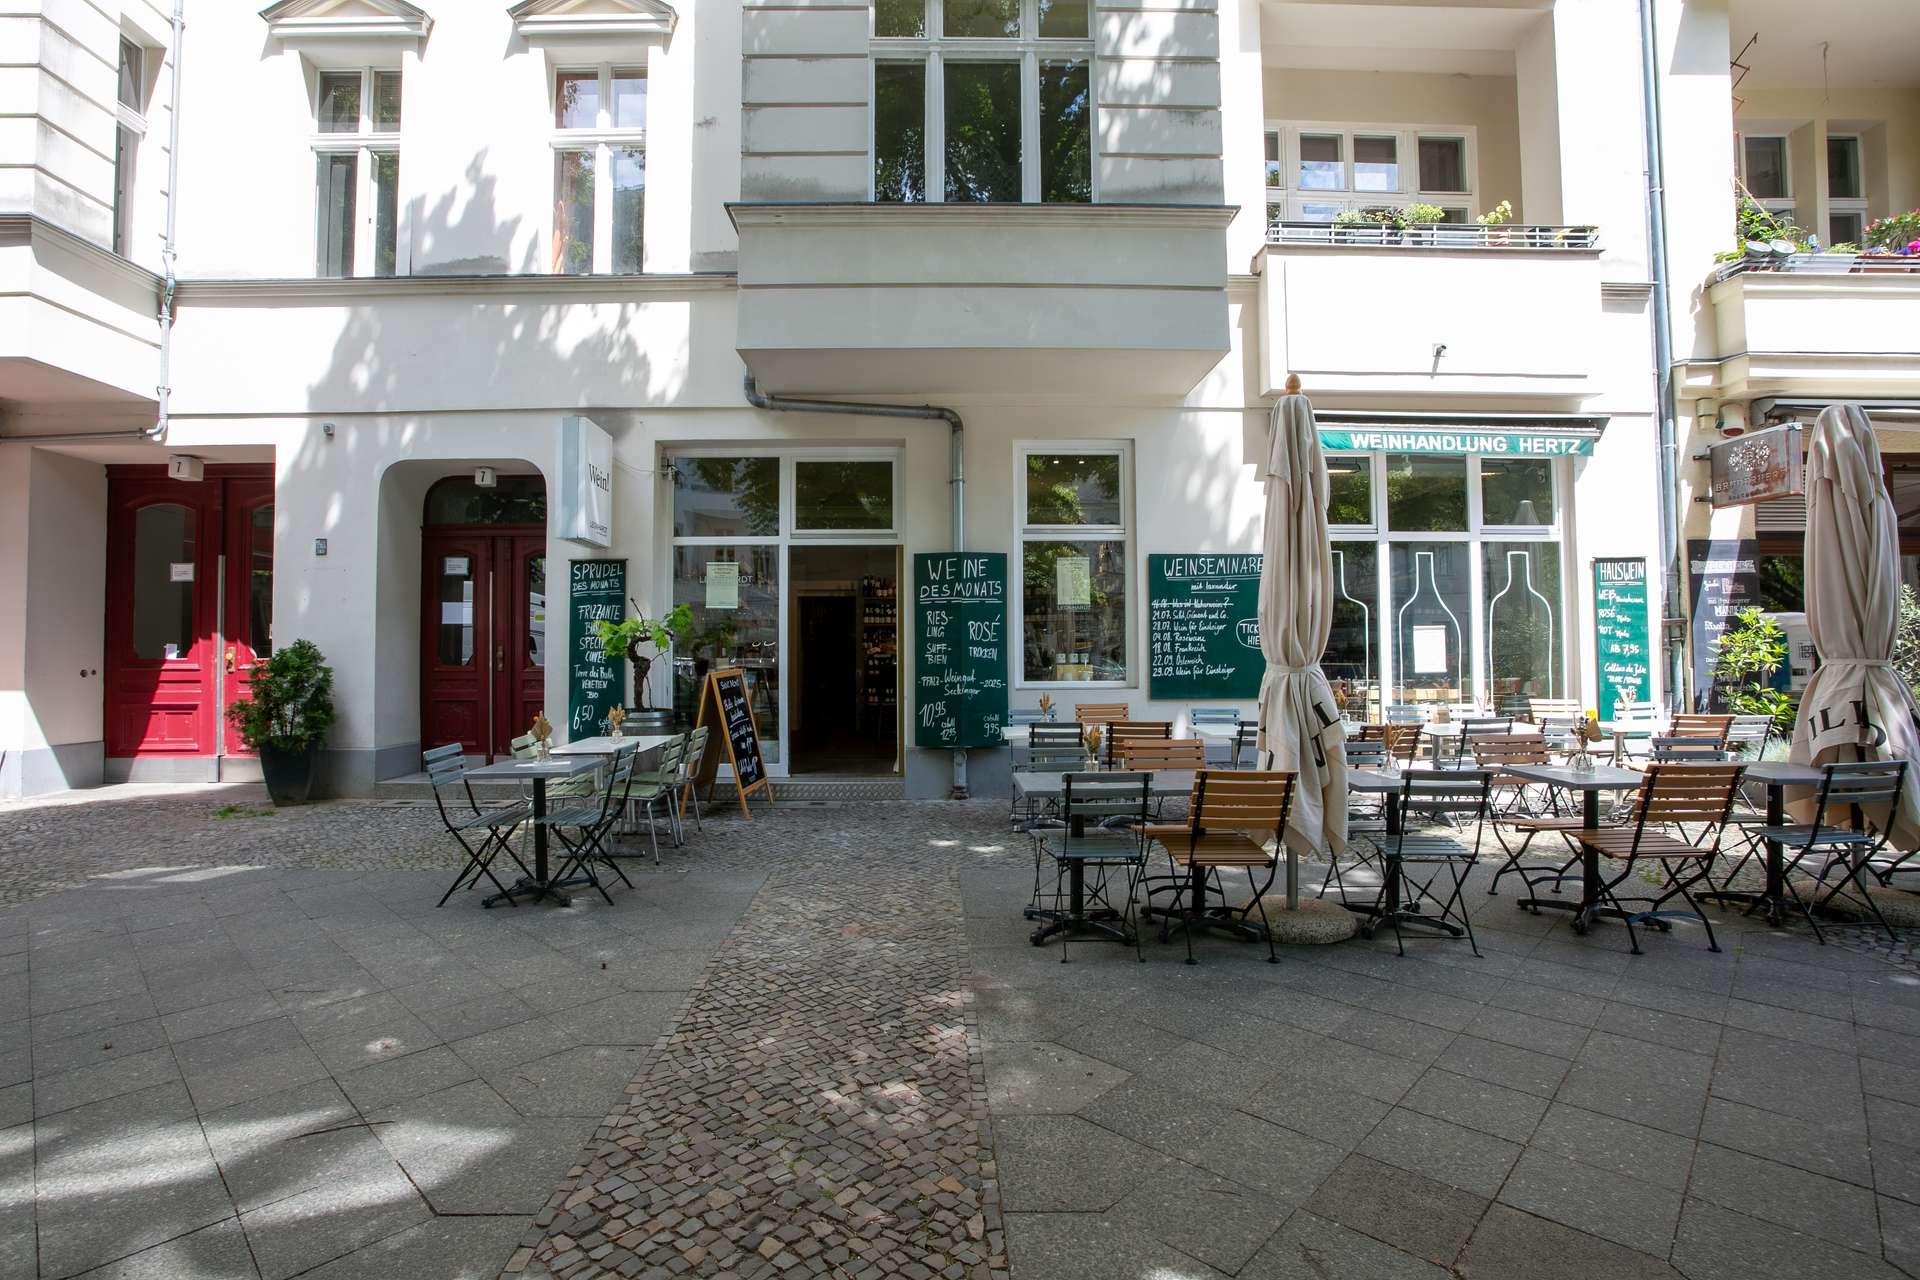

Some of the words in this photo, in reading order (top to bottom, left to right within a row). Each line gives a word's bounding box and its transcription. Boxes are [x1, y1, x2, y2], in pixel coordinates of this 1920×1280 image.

[1350, 433, 1507, 452] WEINHANDLUNG
[1519, 437, 1581, 453] HERTZ
[480, 470, 486, 483] 7
[573, 563, 623, 580] SPRUDEL
[1164, 557, 1263, 577] WEINSEMINARE
[1600, 562, 1645, 581] HAUSWEIN
[572, 582, 588, 591] DES
[590, 579, 620, 590] MONATS
[920, 584, 950, 599] DES
[953, 580, 1002, 598] MONATS
[577, 604, 621, 620] FRIZZANTE
[926, 626, 945, 638] LING
[968, 614, 1000, 642] ROSÉ
[1174, 621, 1187, 631] Wein
[1188, 620, 1197, 633] für
[969, 646, 998, 662] TROCKEN
[1176, 666, 1191, 676] Wein
[1193, 665, 1204, 680] für
[1205, 664, 1236, 681] Einsteiger
